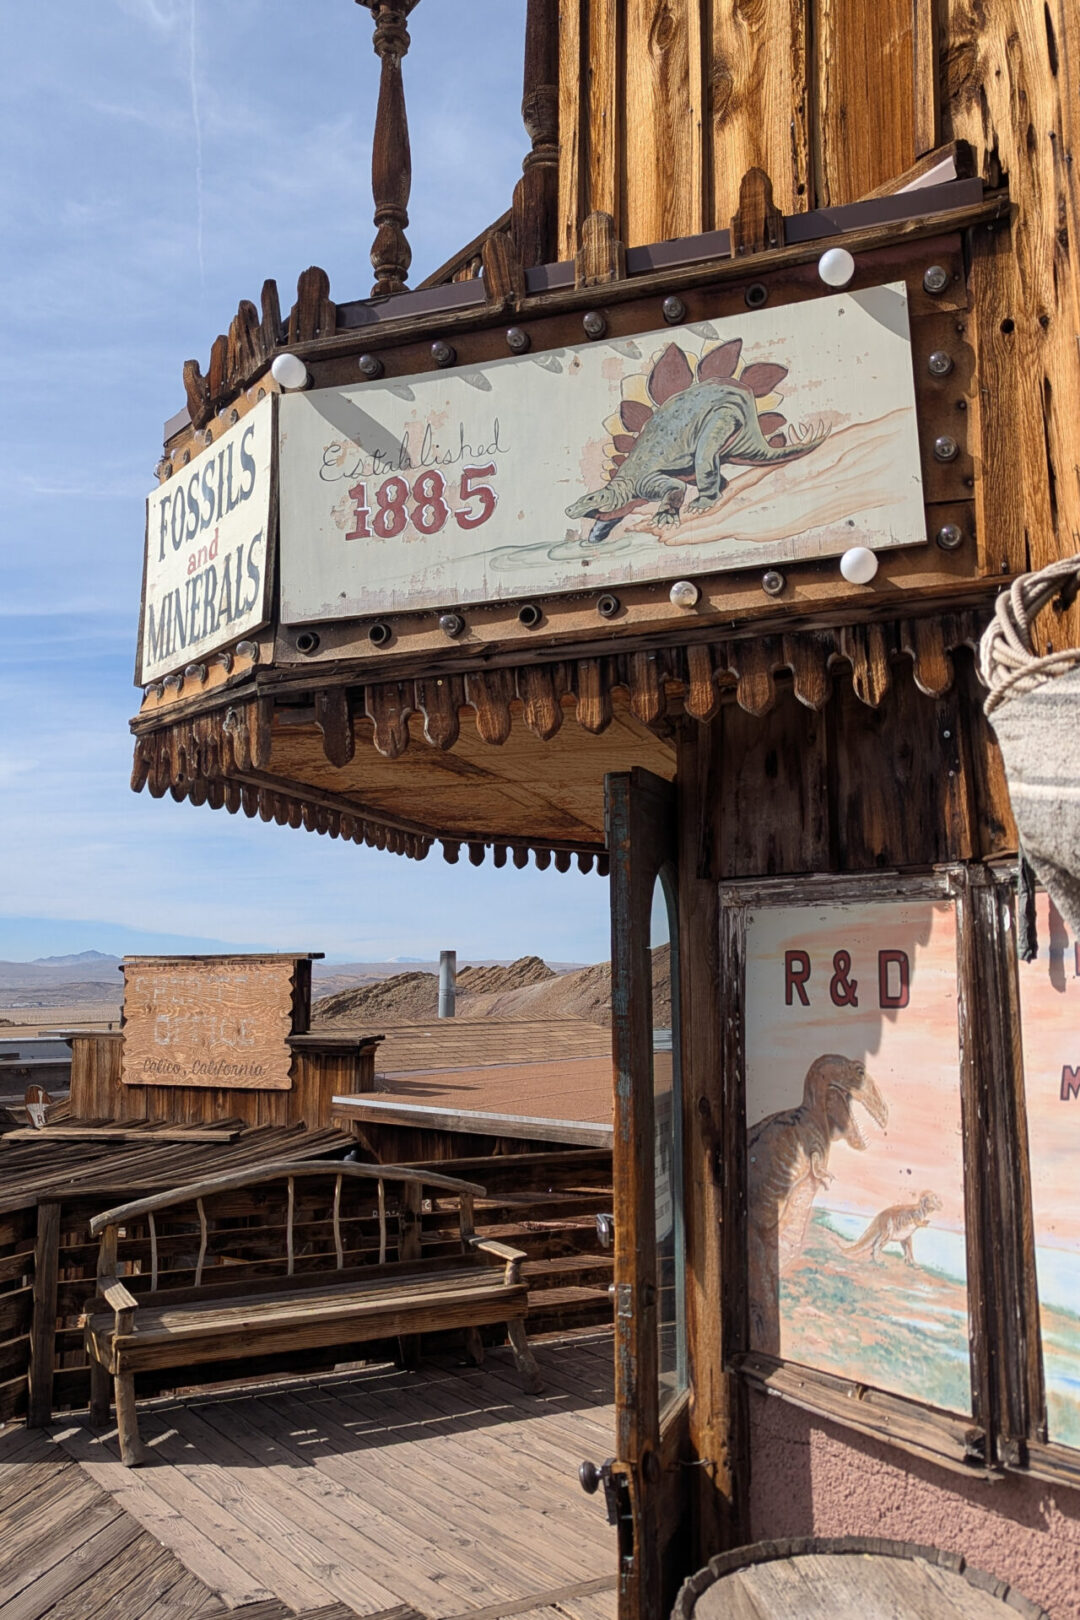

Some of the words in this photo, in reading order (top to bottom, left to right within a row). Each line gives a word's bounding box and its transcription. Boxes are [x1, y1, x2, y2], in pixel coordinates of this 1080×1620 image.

[319, 417, 511, 482] Established
[158, 422, 256, 562] FOSSILS
[345, 460, 499, 541] 1885
[187, 527, 219, 575] and
[146, 527, 262, 667] MINERALS
[785, 950, 811, 1006] R
[830, 950, 858, 1008] &
[878, 950, 910, 1009] D
[154, 1014, 256, 1046] OFFICE
